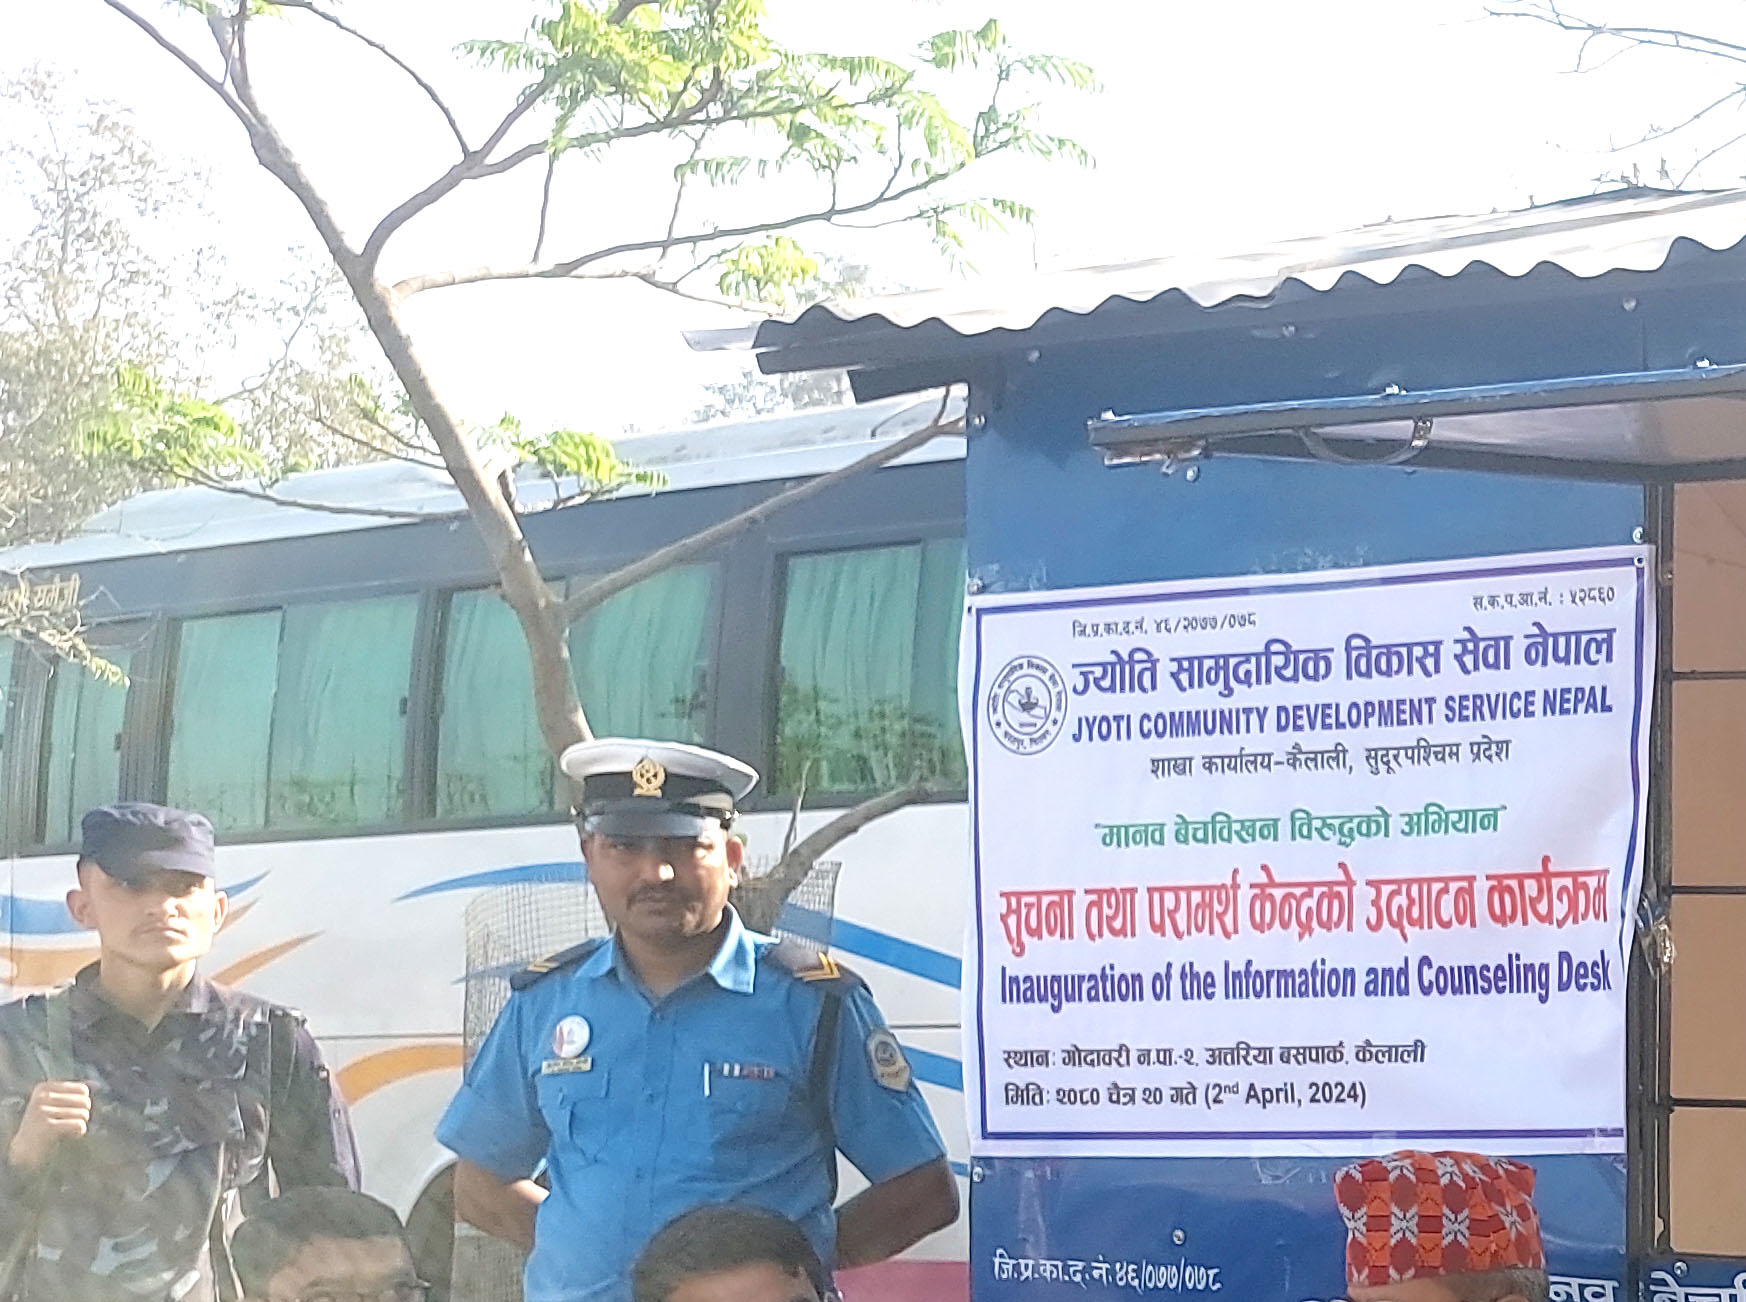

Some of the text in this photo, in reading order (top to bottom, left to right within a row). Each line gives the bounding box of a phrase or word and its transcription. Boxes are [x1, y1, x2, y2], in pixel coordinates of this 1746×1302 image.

[1072, 621, 1616, 698] ज्योति सामुदायिक विकास सेवा नेपाल
[1072, 685, 1613, 742] JYOTI COMMUNITY DEVELOPMENT SERVICE NEPAL
[1150, 756, 1194, 779] शाखा
[1469, 734, 1512, 763] प्रदेश
[1084, 887, 1138, 943] तथा
[1147, 868, 1241, 941] परामर्श
[1249, 862, 1357, 942] केन्द्रको
[1485, 855, 1610, 929] कार्यक्रम
[1001, 950, 1612, 1013] Inauguration of the Information and Counseling Desk
[1061, 1044, 1130, 1068] गोदावरी
[1355, 1039, 1426, 1064] कैलाली
[1056, 1088, 1100, 1105] २०८०
[1107, 1081, 1137, 1106] चैत्र
[1142, 1087, 1163, 1104] २०
[1170, 1081, 1197, 1105] गते
[1245, 1082, 1301, 1109] April,
[1309, 1081, 1366, 1109] 2024)
